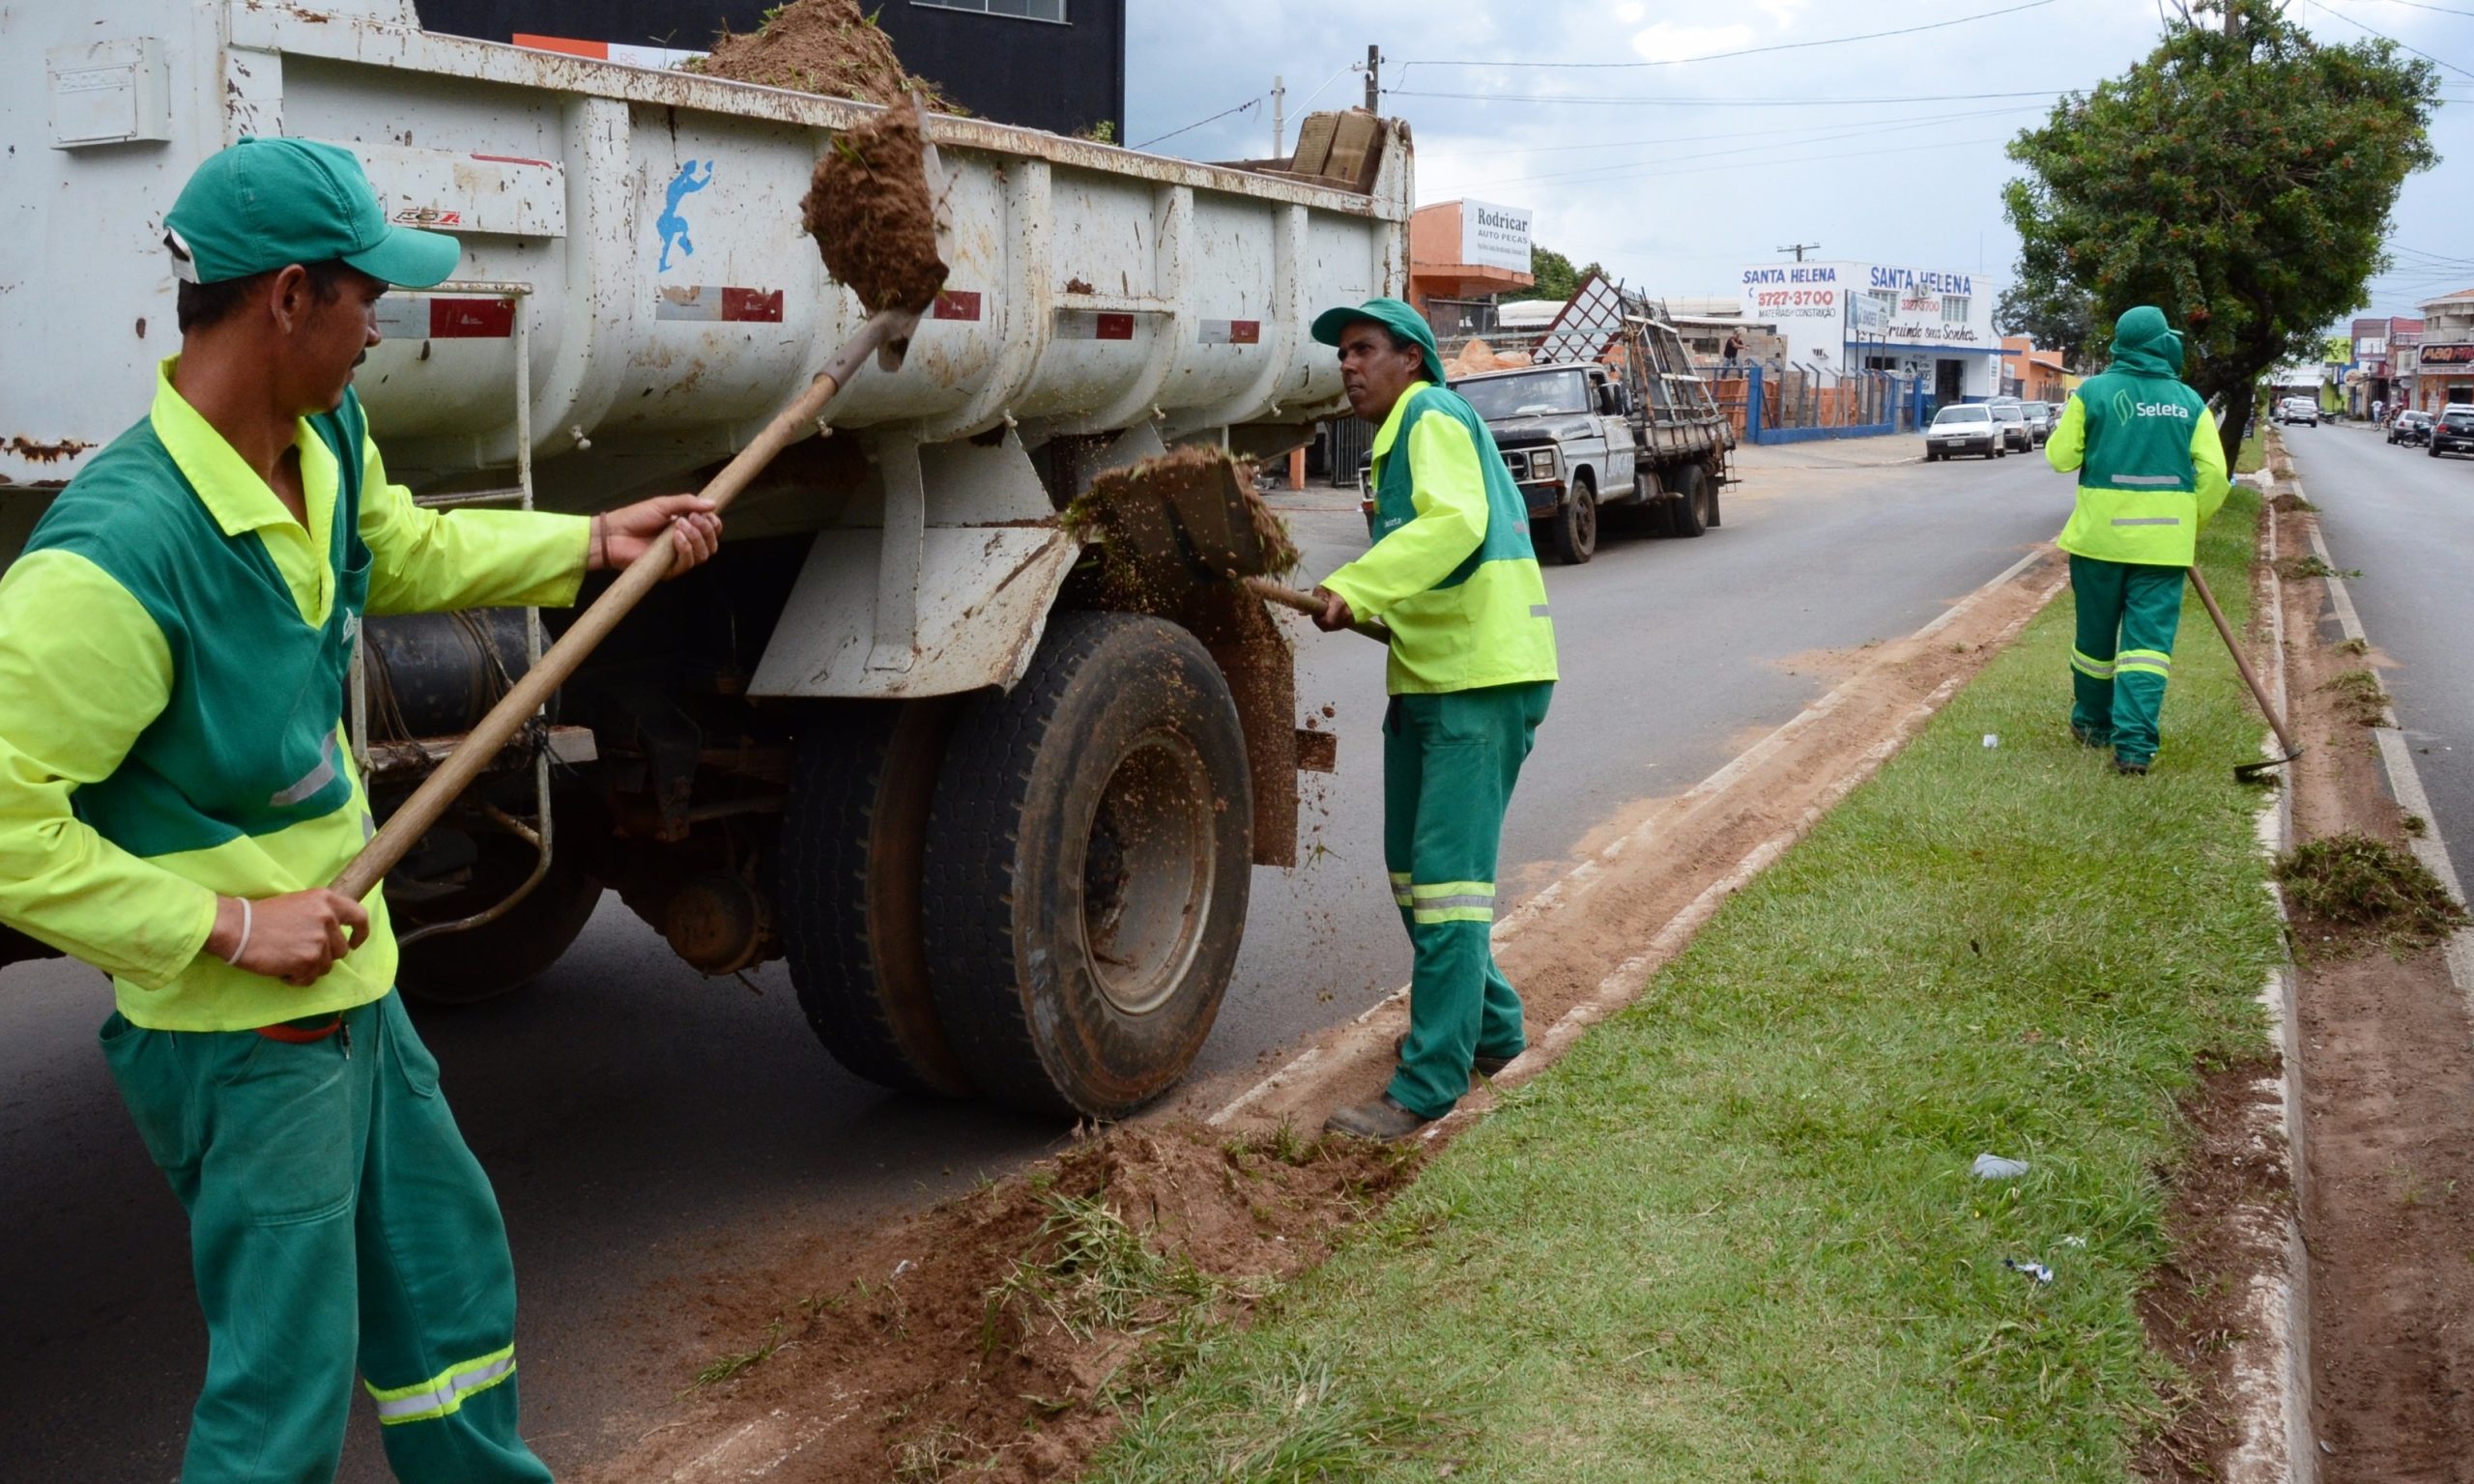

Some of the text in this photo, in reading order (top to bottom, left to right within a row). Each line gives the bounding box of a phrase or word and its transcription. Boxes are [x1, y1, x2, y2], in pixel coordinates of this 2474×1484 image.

[1478, 208, 1528, 232] Rodricar
[1478, 229, 1528, 244] AUTO PEÇAS
[1742, 268, 1835, 284] SANTA HELENA
[1871, 267, 1971, 296] SANTA HELENA
[1796, 307, 1836, 319] CONSTRUÇÃO
[2136, 402, 2189, 418] Seleta
